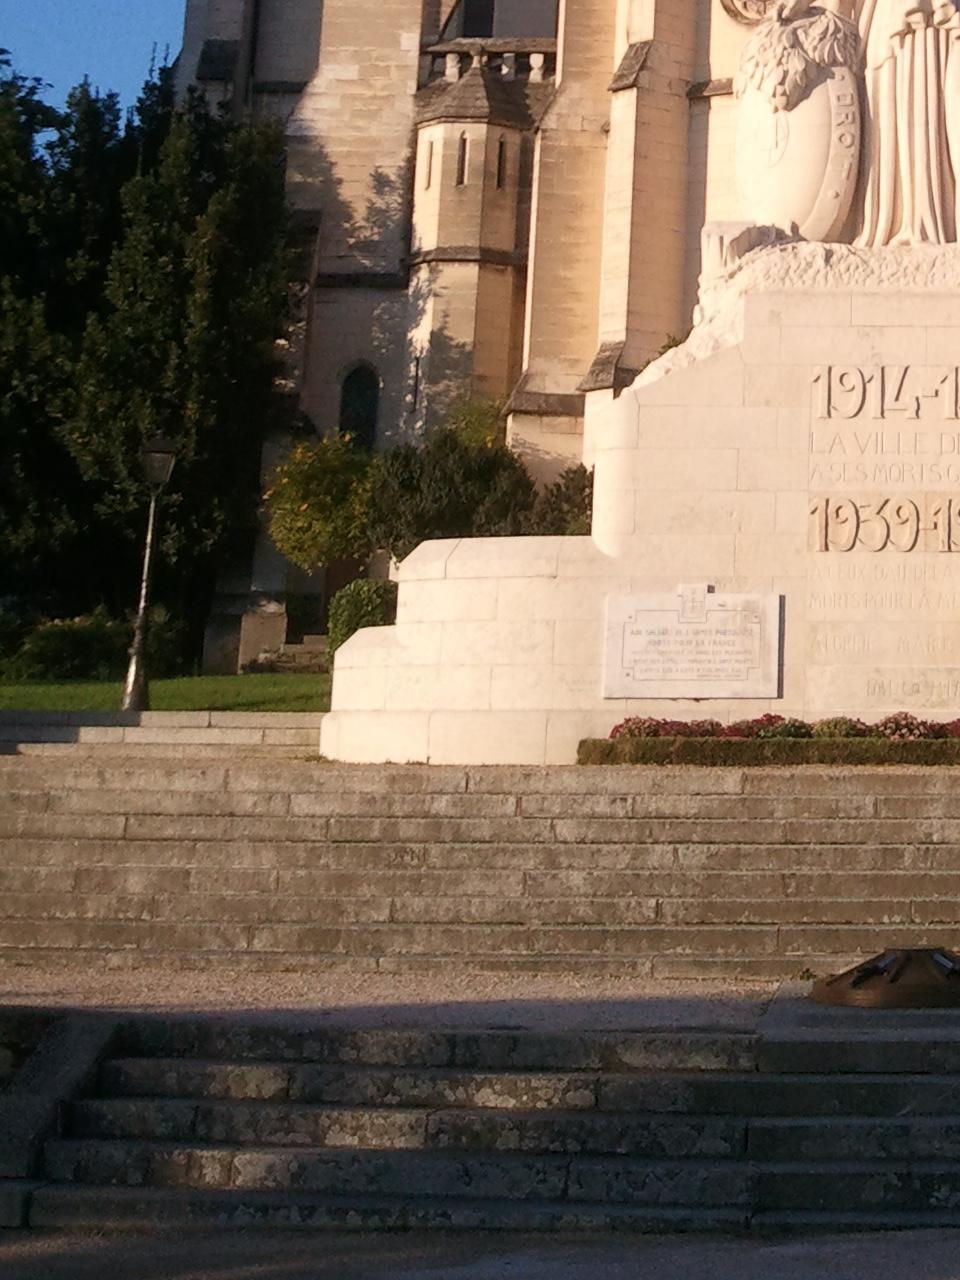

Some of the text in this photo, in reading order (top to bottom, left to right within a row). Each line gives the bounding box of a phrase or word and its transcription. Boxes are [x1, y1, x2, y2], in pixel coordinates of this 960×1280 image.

[810, 431, 847, 455] LA
[853, 431, 929, 455] VILLE
[829, 463, 868, 483] SES
[873, 463, 942, 484] MORTS
